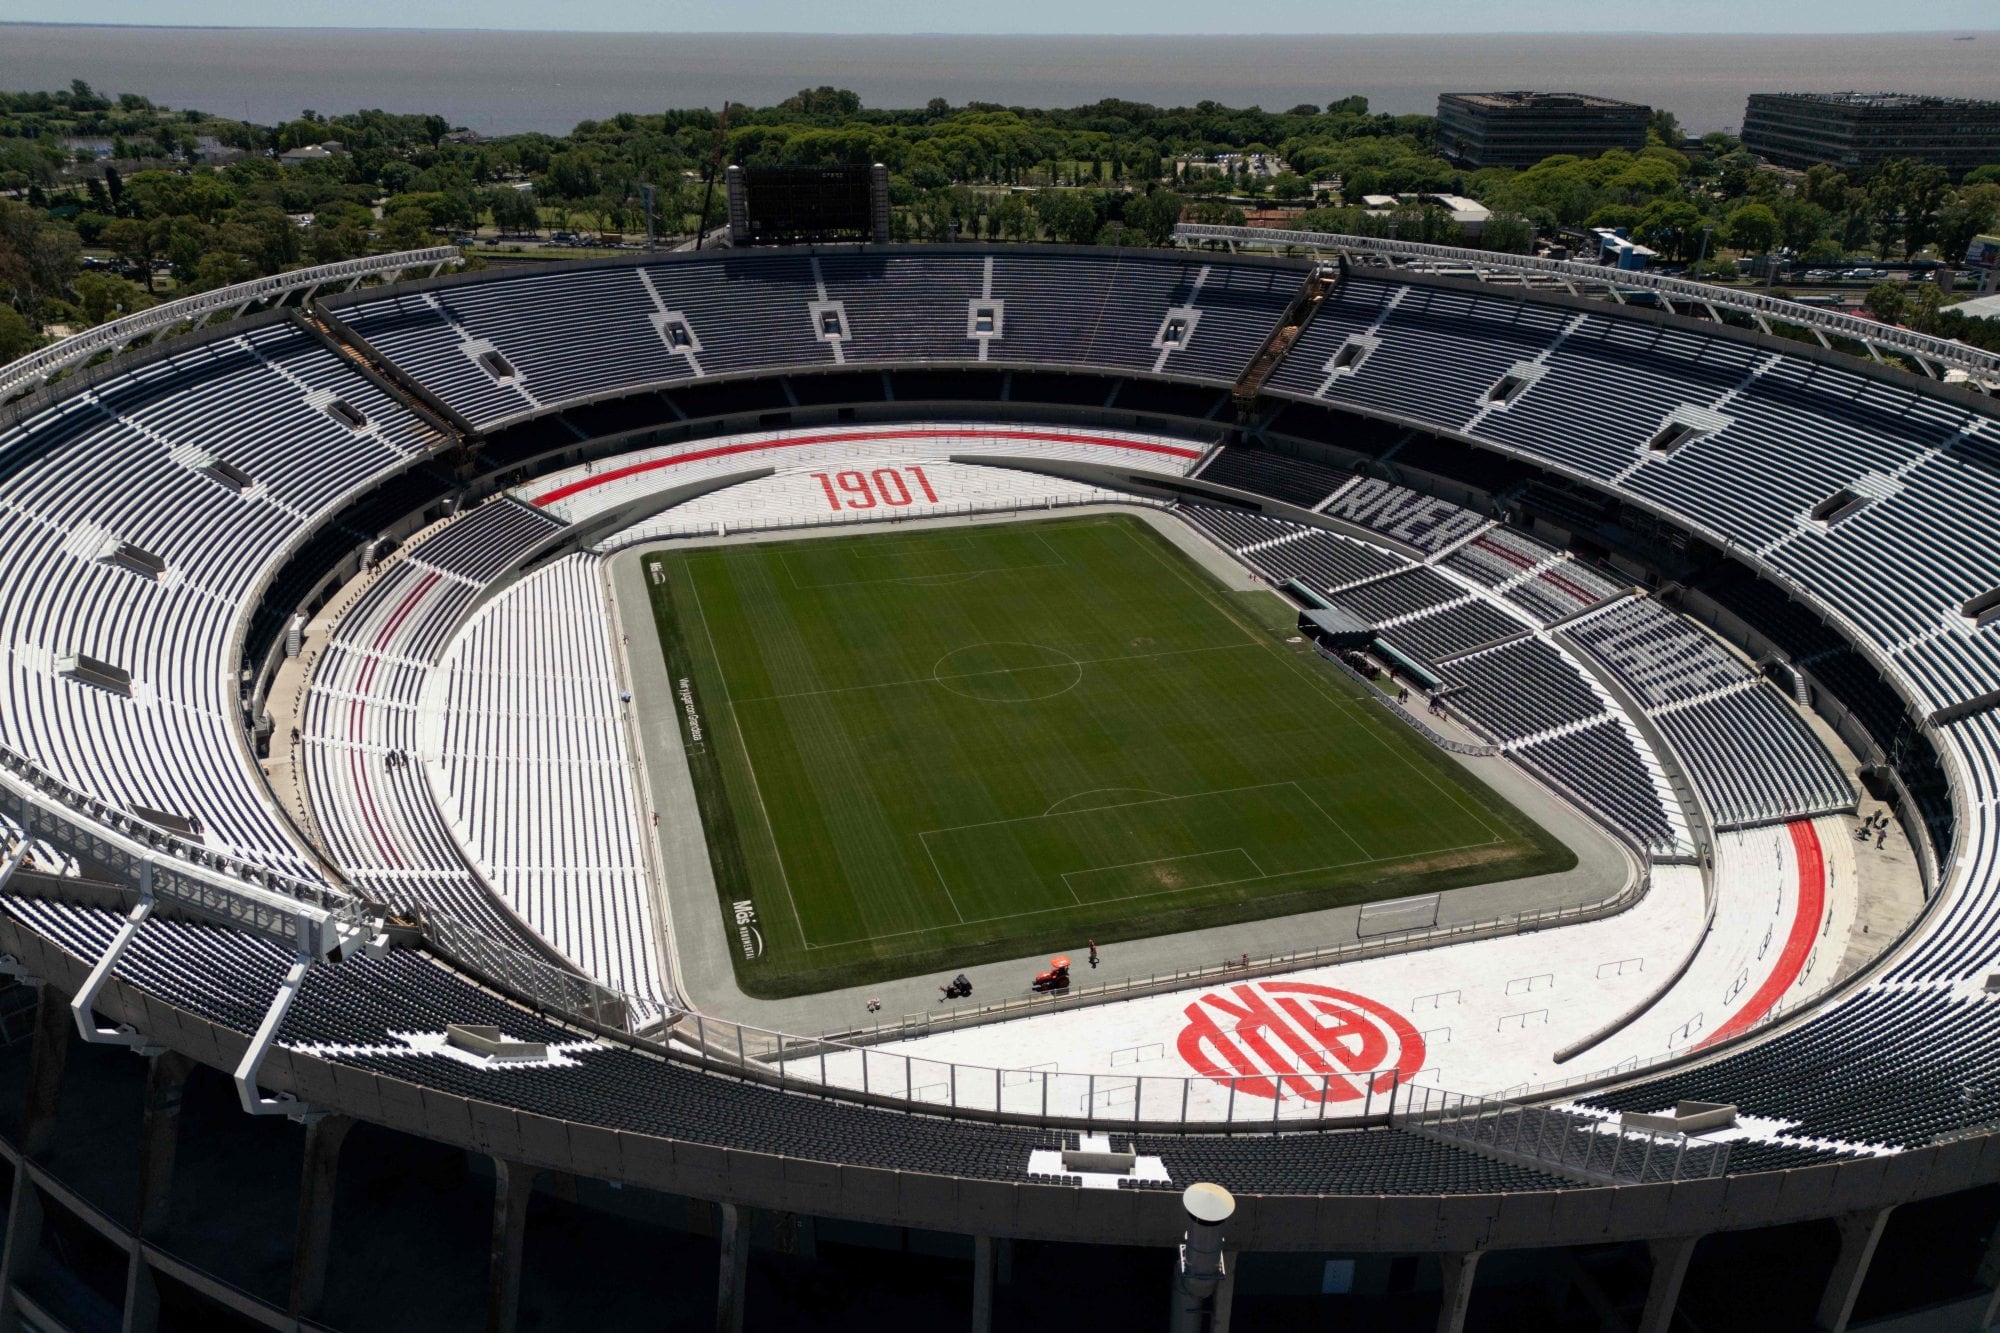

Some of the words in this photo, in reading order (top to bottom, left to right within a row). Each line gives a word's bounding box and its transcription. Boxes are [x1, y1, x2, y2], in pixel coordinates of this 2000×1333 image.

[809, 466, 939, 510] 1901
[1327, 477, 1484, 551] RIVER
[1574, 596, 1750, 705] PLATE
[685, 704, 695, 714] con
[688, 714, 702, 740] Grandeza
[739, 926, 755, 960] MONUMENTAL
